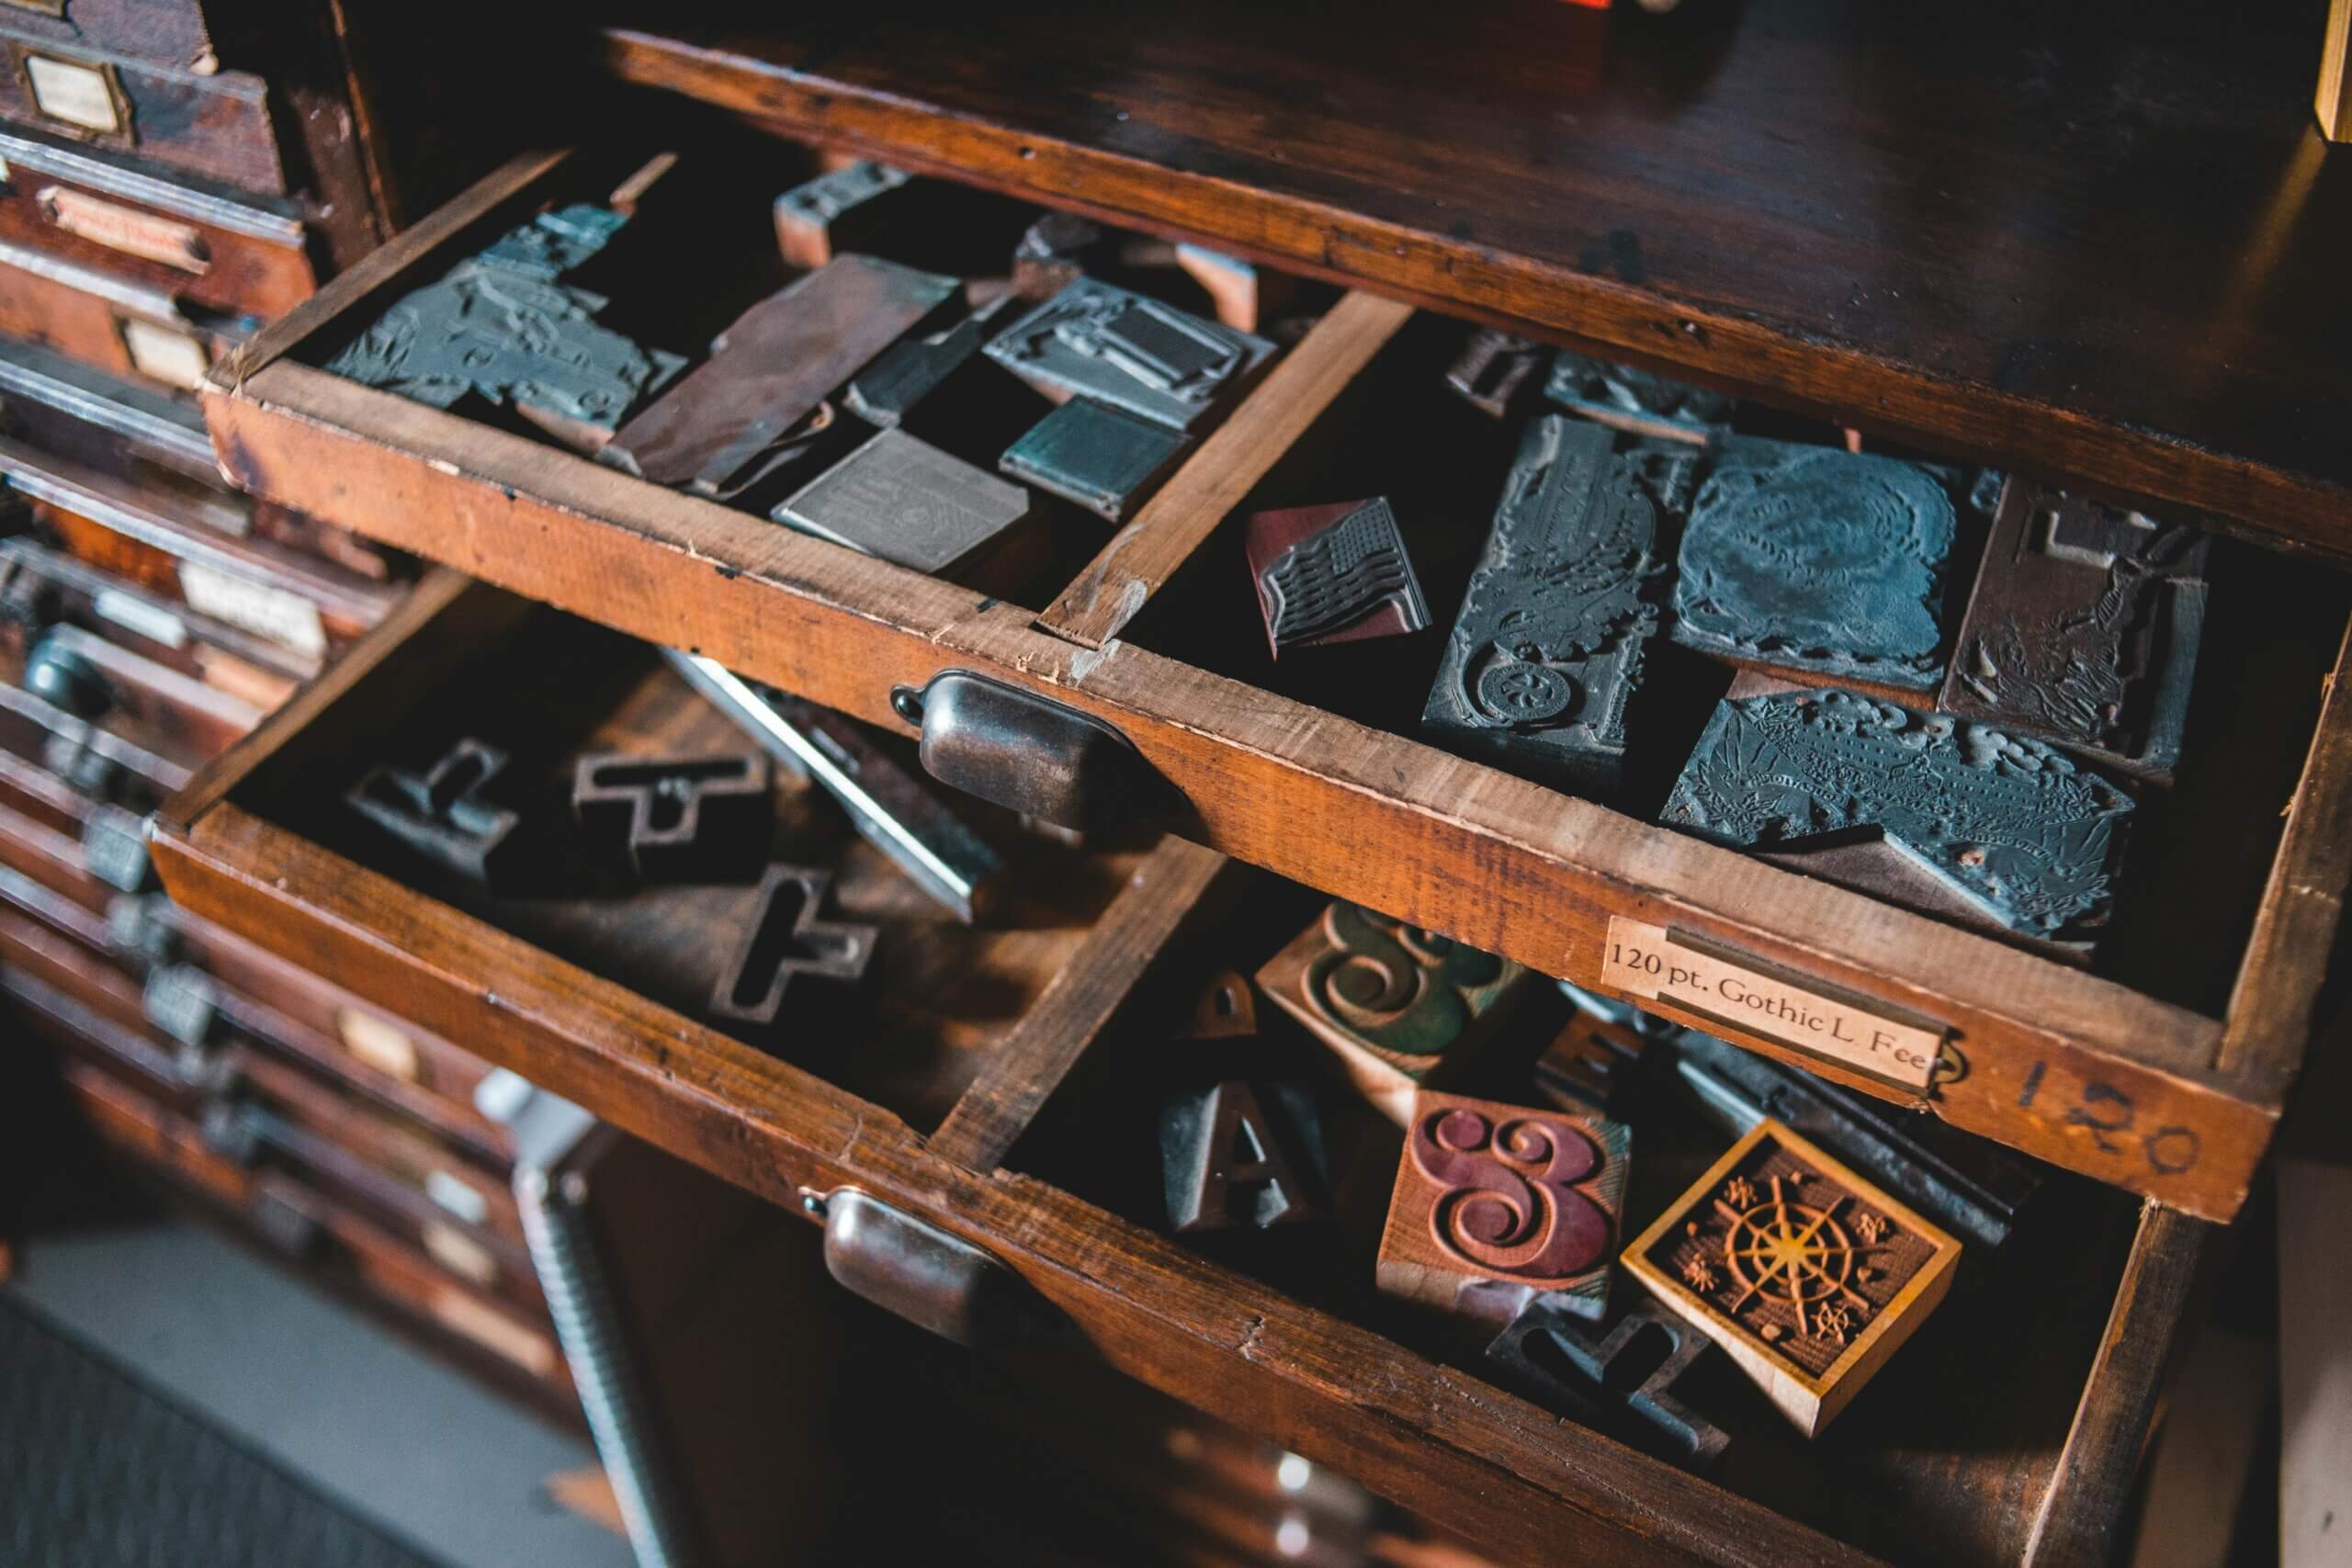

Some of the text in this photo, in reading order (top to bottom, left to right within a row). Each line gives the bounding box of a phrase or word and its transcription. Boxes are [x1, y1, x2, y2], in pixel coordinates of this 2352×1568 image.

[1611, 942, 1661, 976] 120
[1668, 964, 1709, 992] pt.
[1718, 977, 1824, 1032] Gothic
[1191, 1080, 1328, 1227] A
[2018, 1059, 2202, 1176] 120
